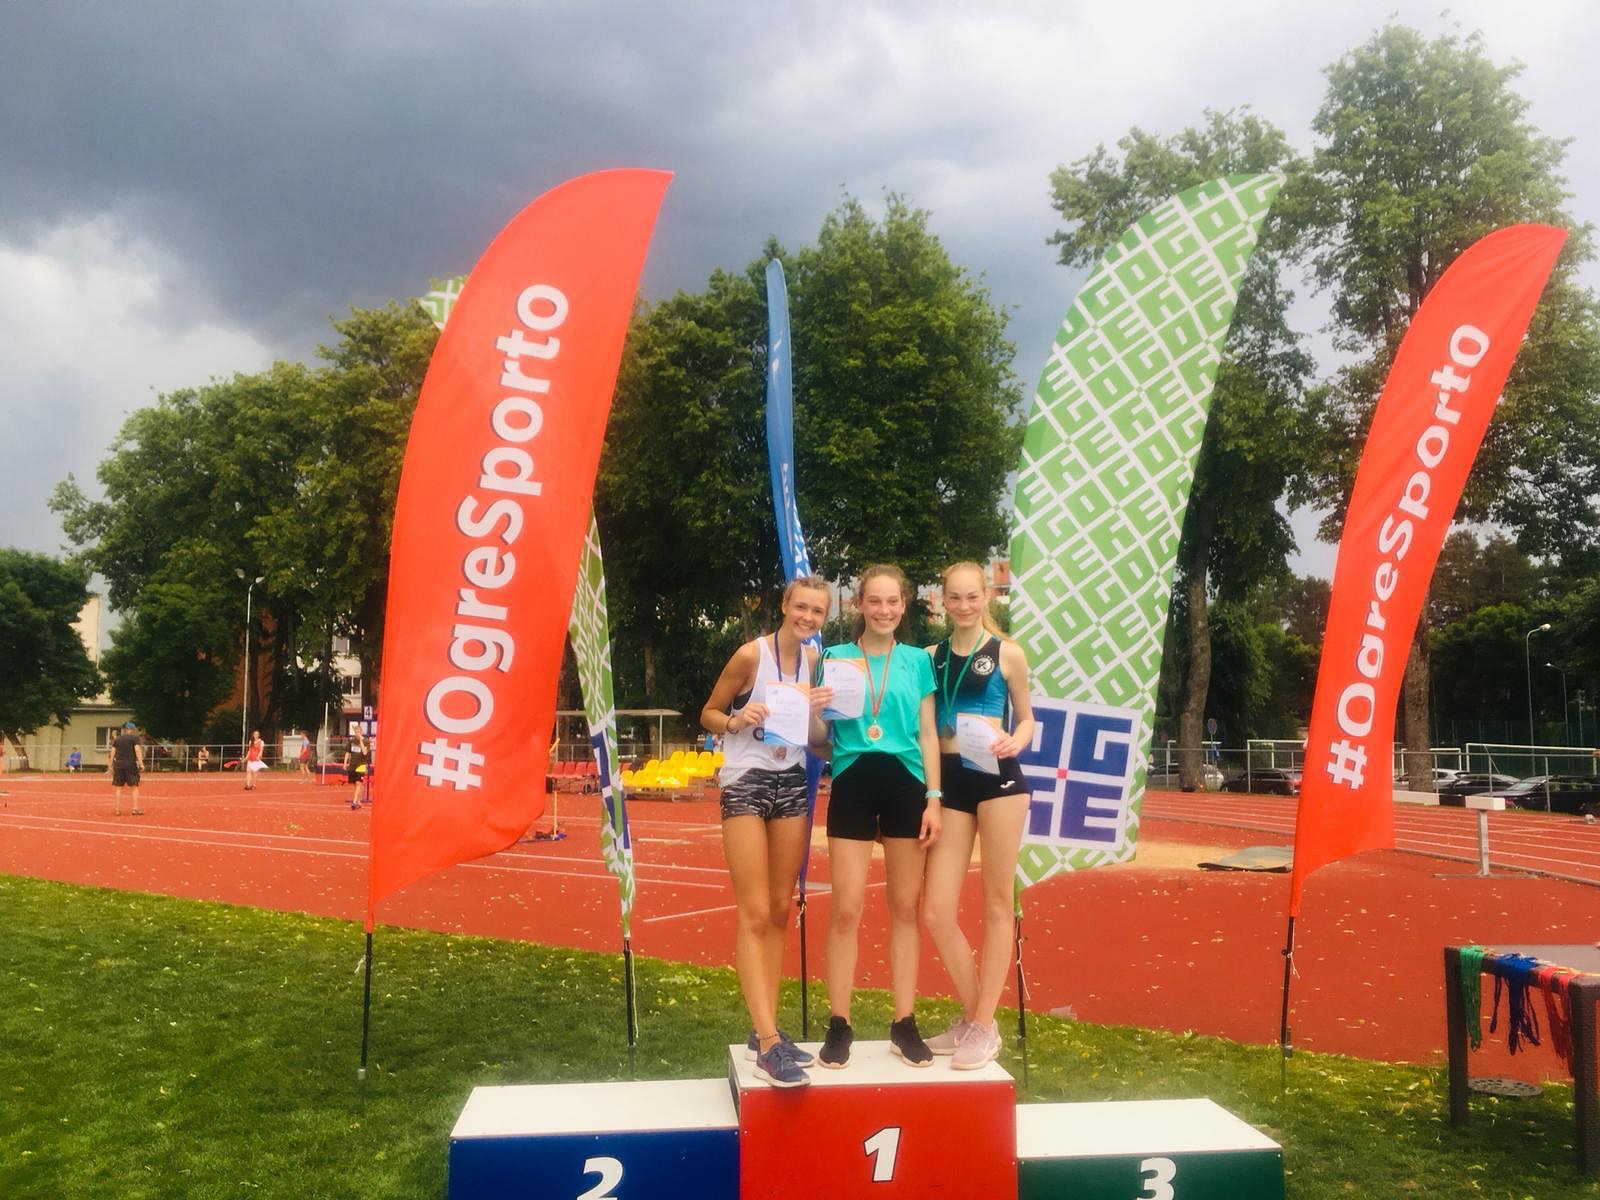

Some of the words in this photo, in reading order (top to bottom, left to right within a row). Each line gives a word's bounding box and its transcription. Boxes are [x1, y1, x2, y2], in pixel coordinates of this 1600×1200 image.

[416, 283, 569, 791] #OgreSporto
[576, 1156, 624, 1200] 2
[863, 1127, 901, 1182] 1
[1136, 1156, 1178, 1200] 3
